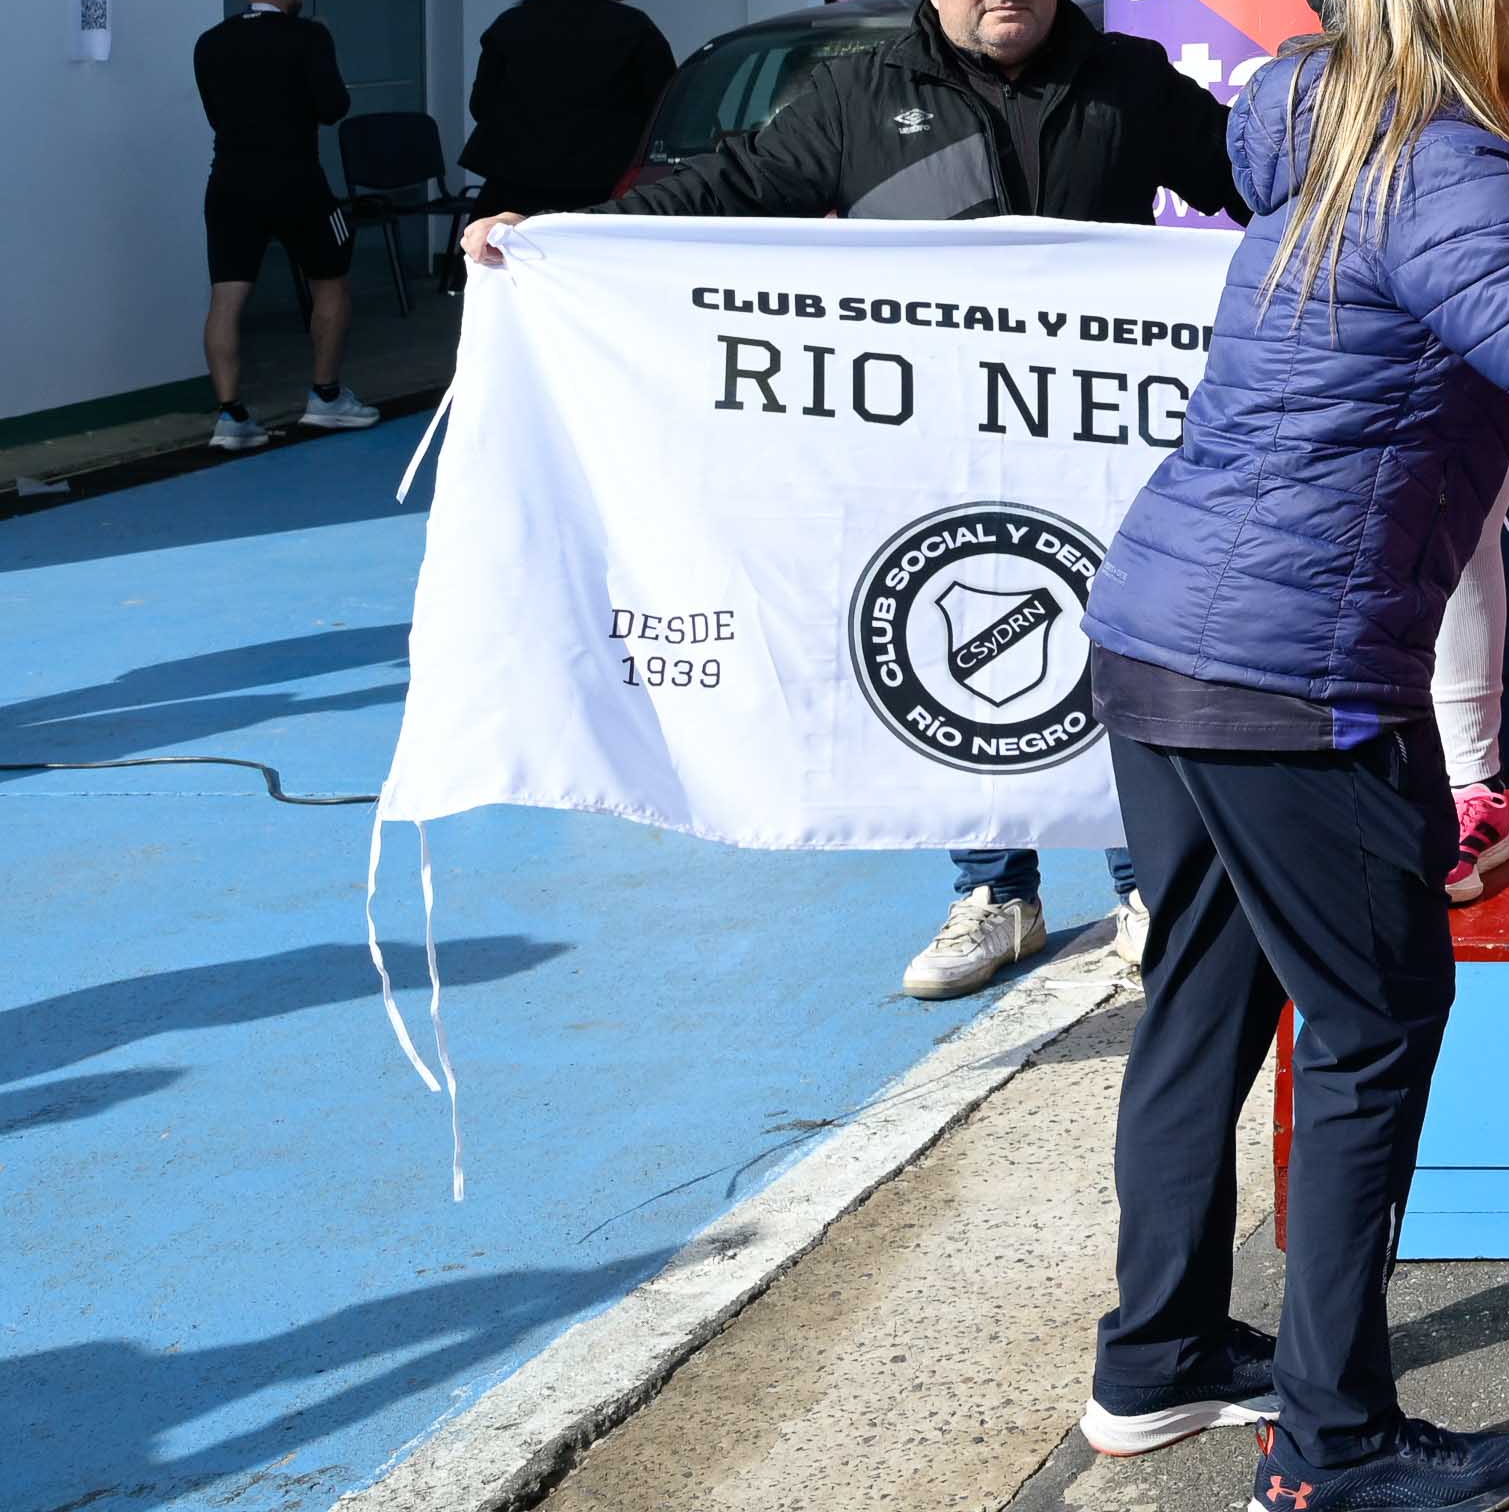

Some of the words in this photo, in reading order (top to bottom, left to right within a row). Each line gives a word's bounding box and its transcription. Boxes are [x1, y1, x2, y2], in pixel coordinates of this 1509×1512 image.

[692, 287, 826, 318] CLUB
[838, 297, 1026, 333] SOCIAL
[1038, 311, 1067, 337] Y
[715, 334, 914, 426] RIO
[886, 524, 996, 591] SOCIAL
[1006, 524, 1029, 544] Y
[609, 609, 734, 644] DESDE
[872, 596, 903, 687] CLUB
[956, 600, 1046, 668] CSyDRN
[622, 656, 720, 688] 1939
[906, 705, 962, 747] RÍO
[972, 711, 1086, 755] NEGRO
